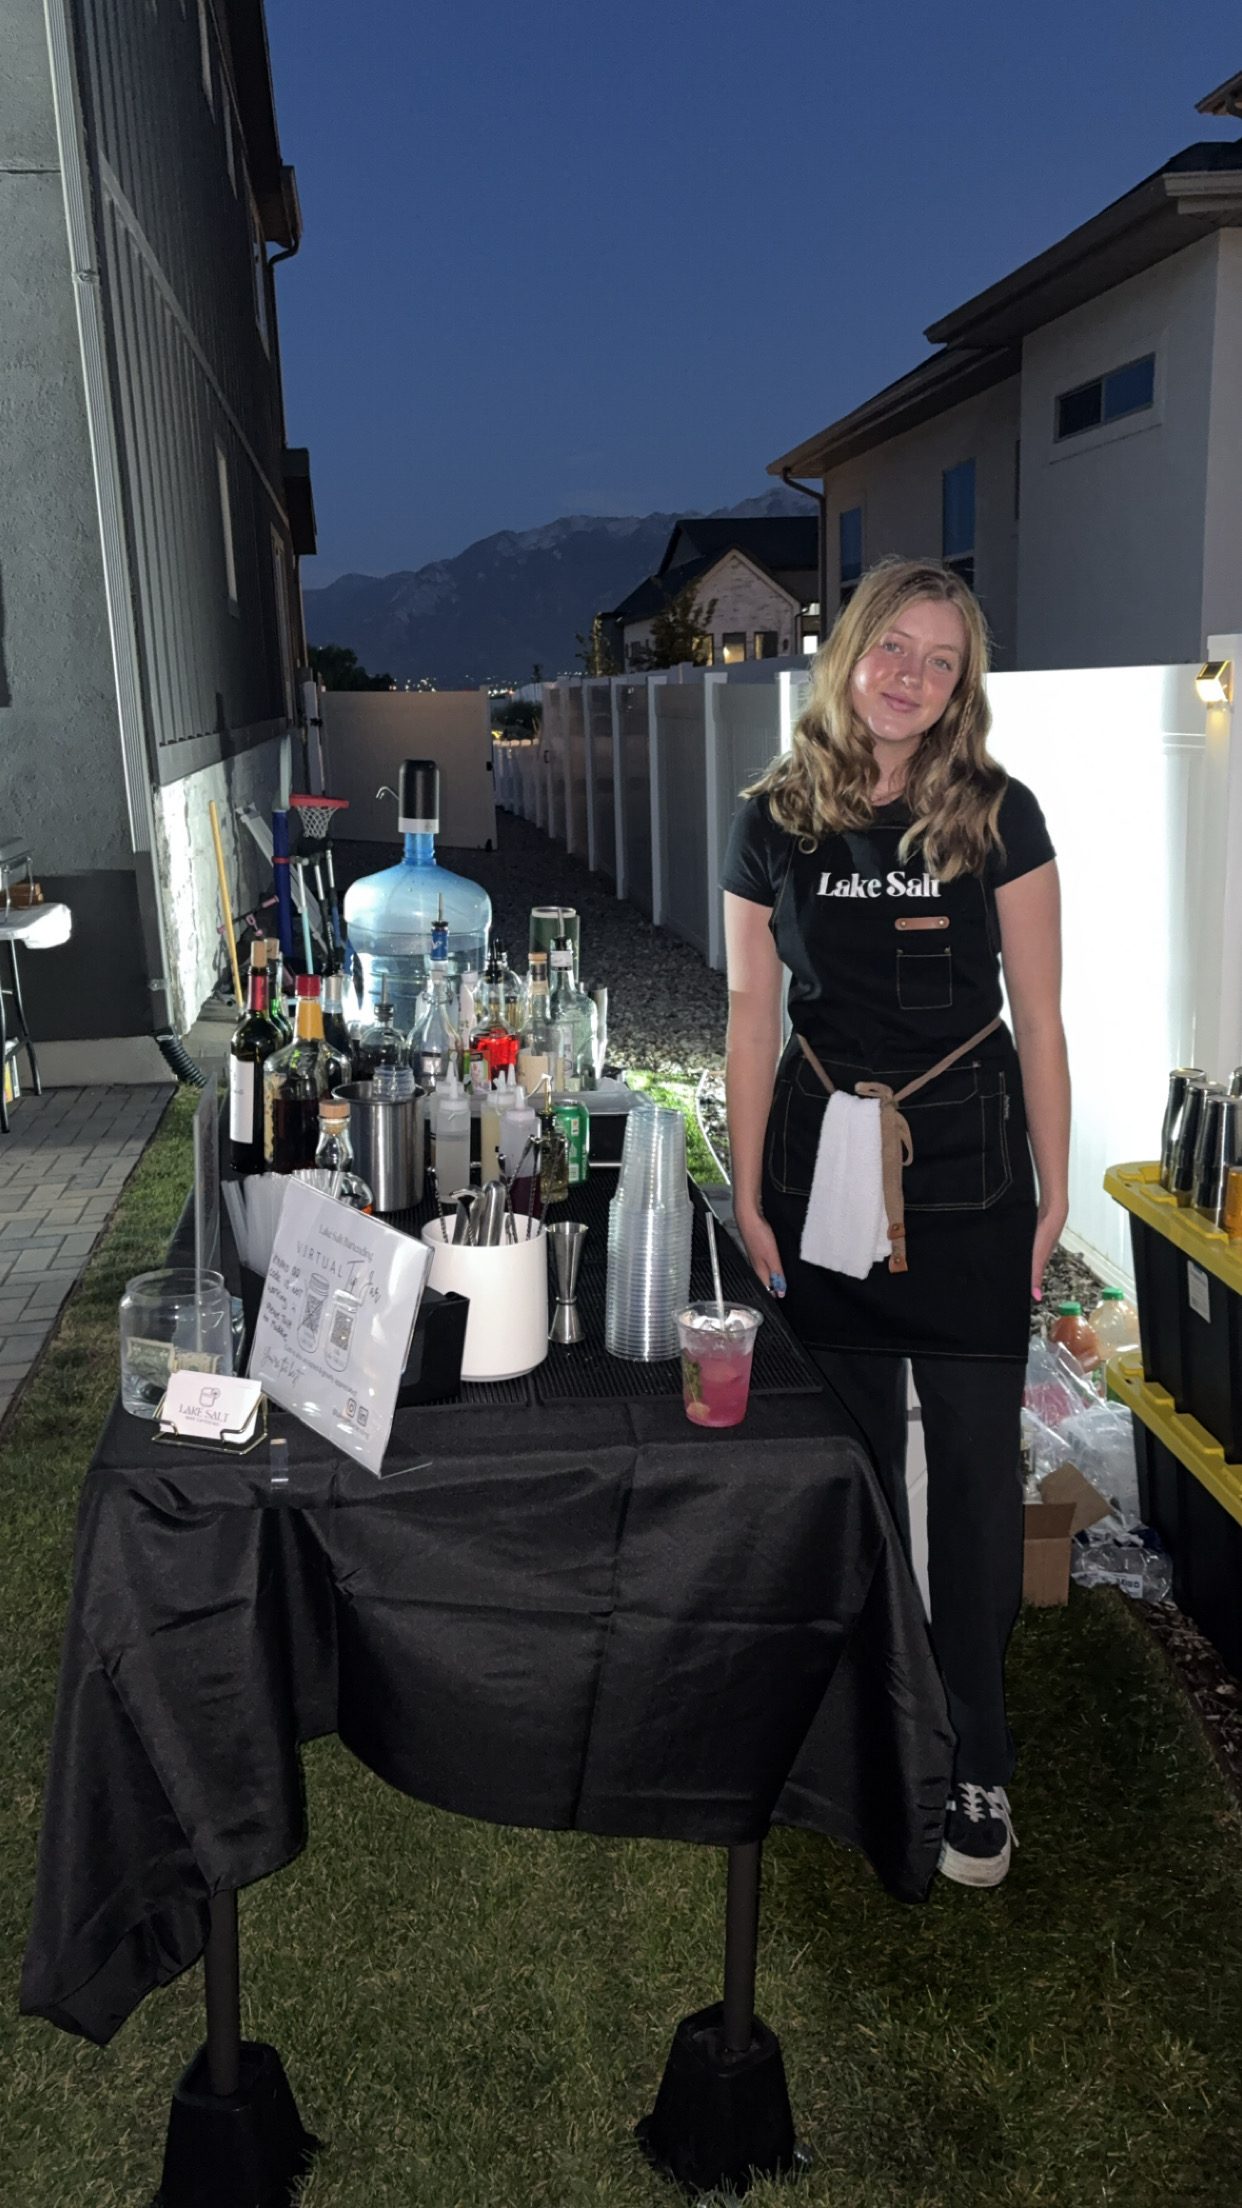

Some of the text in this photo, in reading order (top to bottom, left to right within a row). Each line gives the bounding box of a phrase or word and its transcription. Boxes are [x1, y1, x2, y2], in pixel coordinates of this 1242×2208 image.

[816, 871, 942, 898] Lake Salt
[297, 1240, 343, 1278] VIRTUAL
[178, 1403, 202, 1417] LAKE
[205, 1409, 230, 1423] SALT
